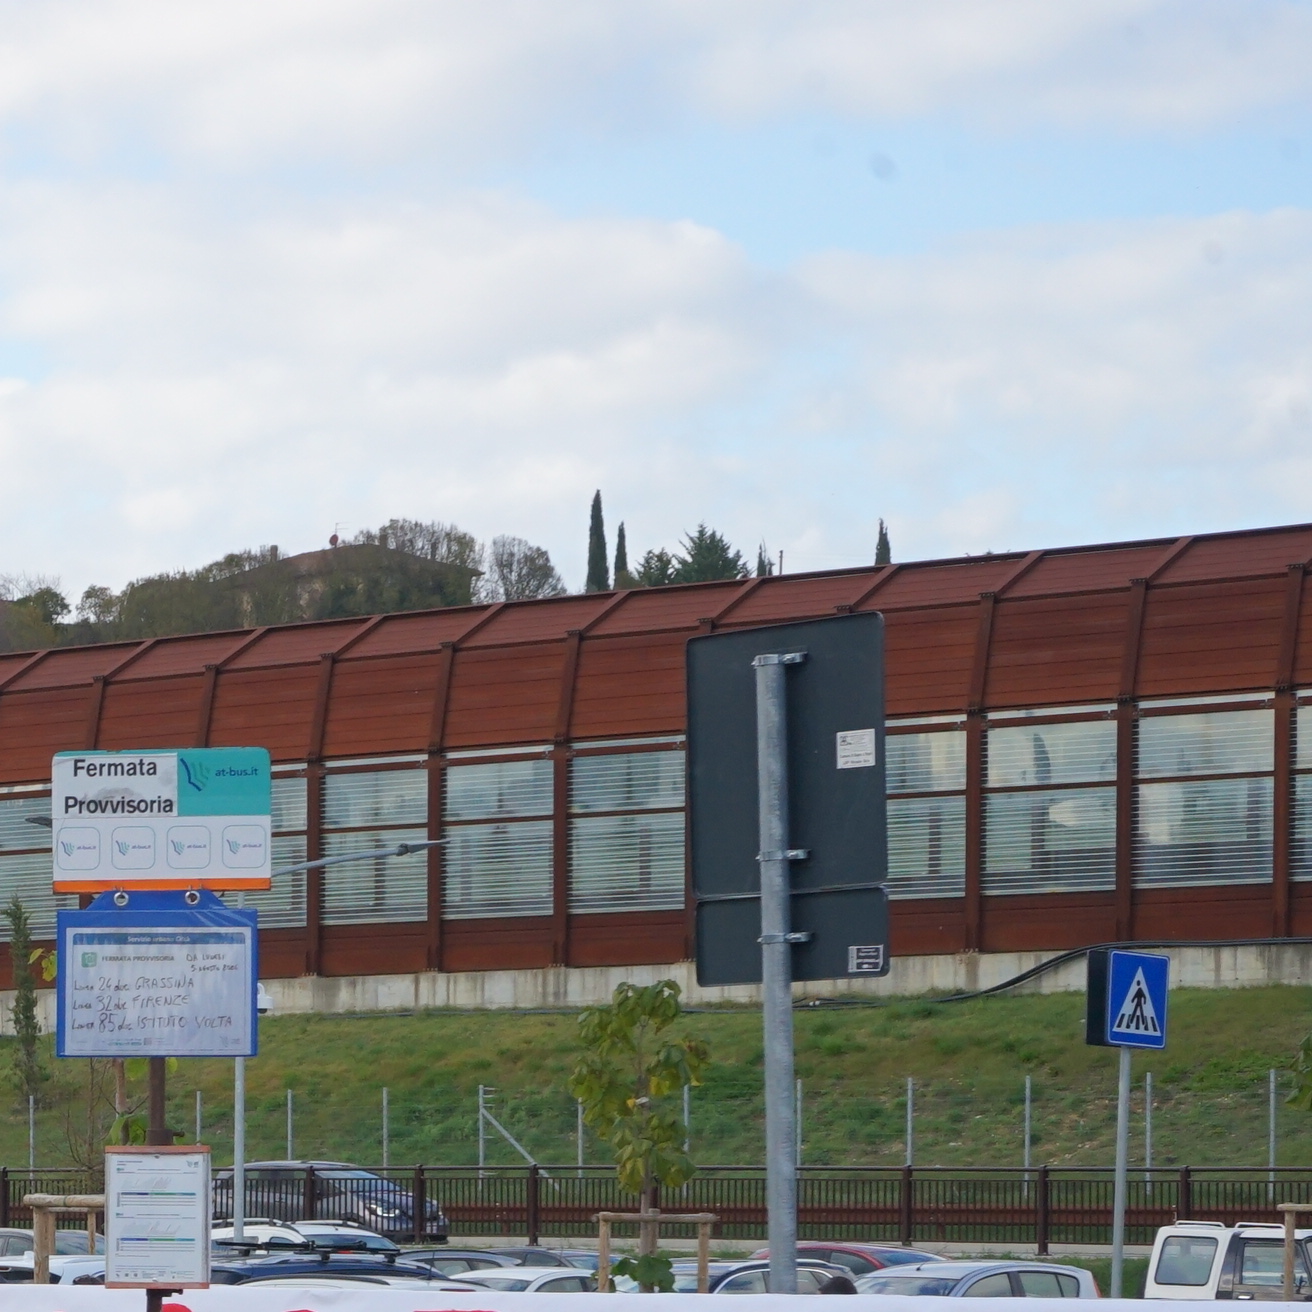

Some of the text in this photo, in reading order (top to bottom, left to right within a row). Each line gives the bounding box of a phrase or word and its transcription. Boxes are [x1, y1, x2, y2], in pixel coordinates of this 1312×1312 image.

[73, 758, 157, 777] Fermata
[215, 766, 259, 777] at-bus.it
[64, 796, 174, 814] Provvisoria
[135, 976, 194, 991] GRASSINA
[96, 995, 113, 1012] 32
[132, 994, 189, 1009] FIRENZE
[99, 1012, 118, 1033] 85
[137, 1016, 187, 1030] ISTITUTO
[195, 1016, 232, 1029] VOLTA
